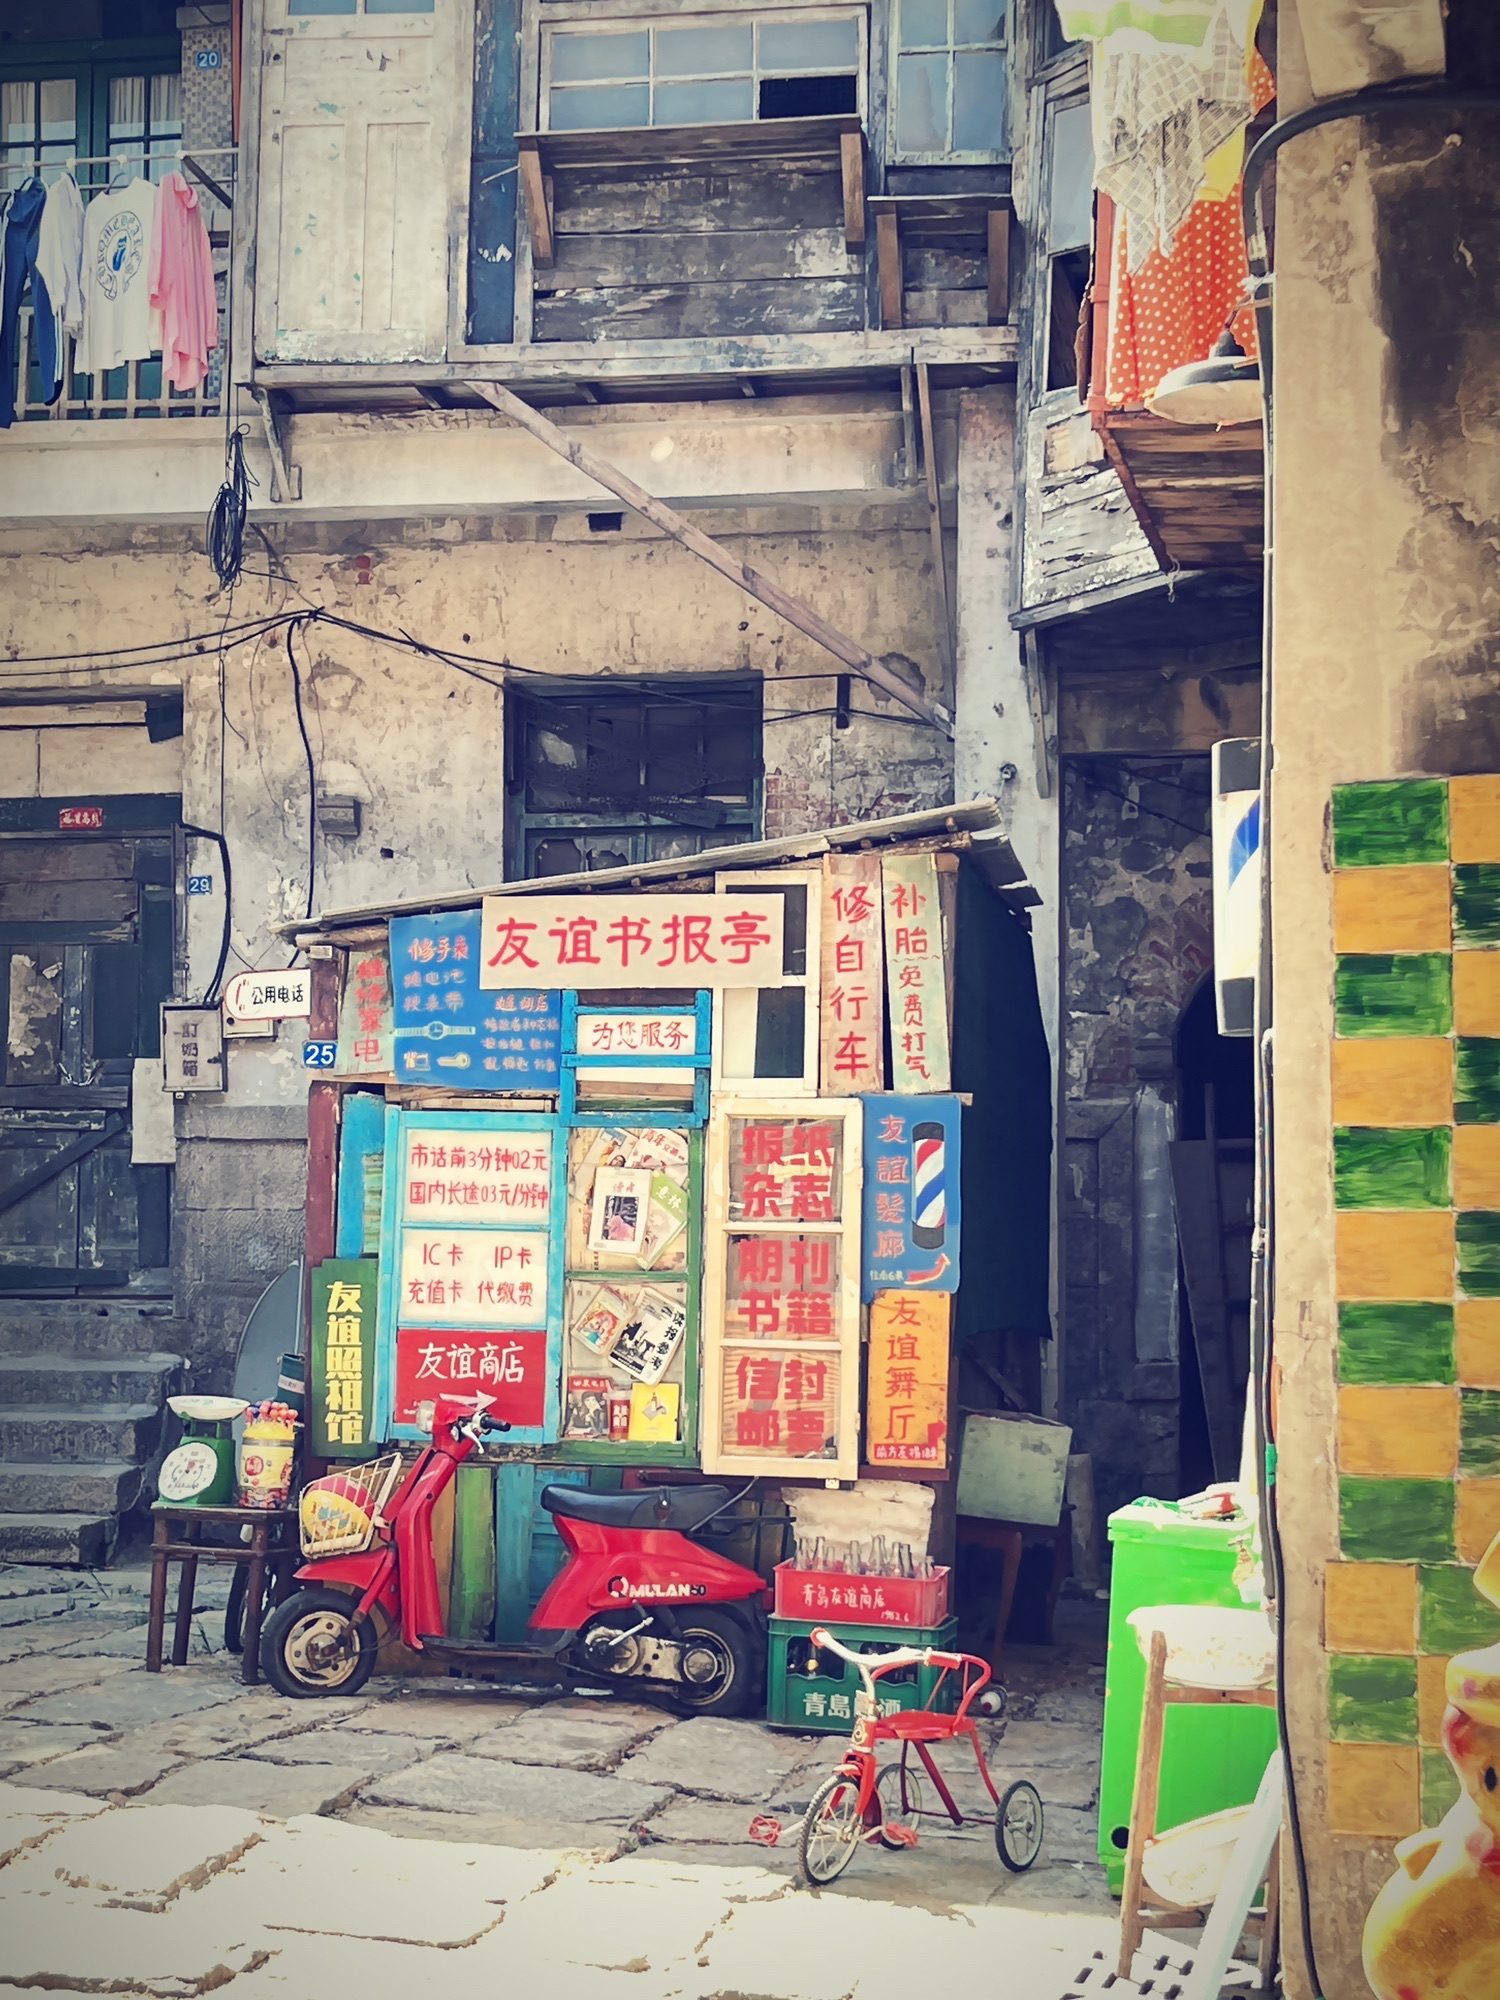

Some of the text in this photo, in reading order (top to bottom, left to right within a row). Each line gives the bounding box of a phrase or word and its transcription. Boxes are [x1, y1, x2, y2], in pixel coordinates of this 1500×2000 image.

[199, 52, 217, 67] 20
[190, 878, 210, 893] 29
[487, 911, 771, 968] 友谊书报亭
[251, 983, 304, 1005] 公用电话
[829, 885, 874, 1079] 修自行车
[891, 883, 931, 1079] 补胎 免费打气
[305, 1044, 334, 1065] 25
[592, 1021, 688, 1050] 为您服务
[742, 1125, 833, 1167] 报纸
[742, 1173, 833, 1219] 杂志
[737, 1239, 830, 1285] 期刊
[408, 1279, 533, 1307] 充值卡 代缴费
[737, 1291, 833, 1335] 书籍
[325, 1281, 363, 1444] 友谊照相馆
[415, 1340, 524, 1385] 友谊商店
[735, 1356, 829, 1401] 信封
[885, 1297, 922, 1441] 友谊舞厅
[736, 1409, 826, 1456] 邮票
[803, 1692, 901, 1719] 青島酒
